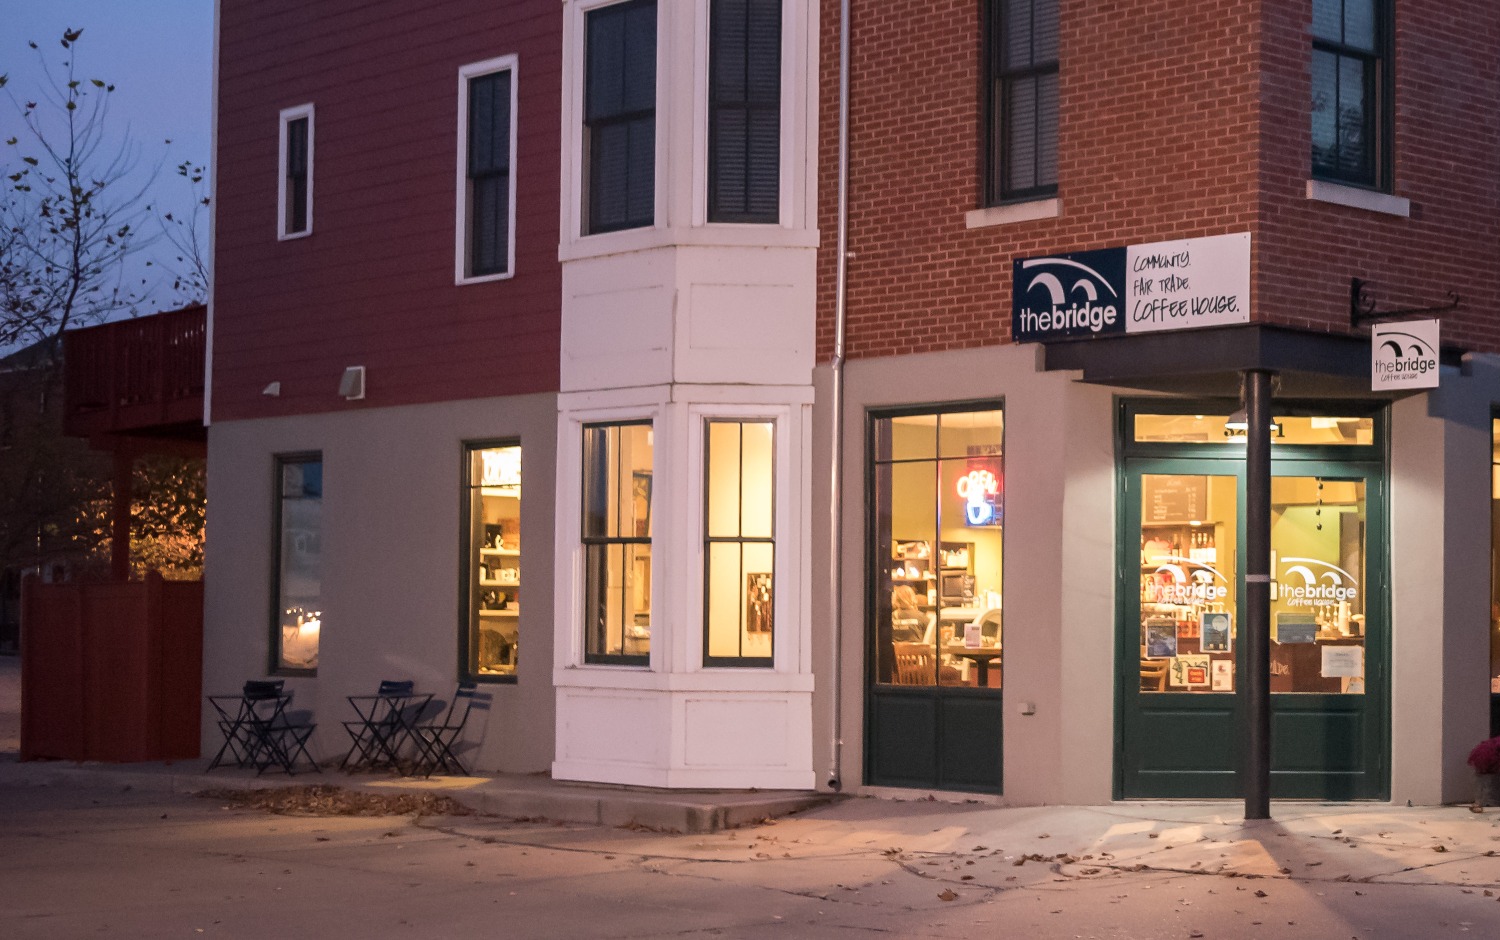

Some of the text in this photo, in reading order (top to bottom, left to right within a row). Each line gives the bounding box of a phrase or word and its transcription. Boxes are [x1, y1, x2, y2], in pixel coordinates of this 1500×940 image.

[1133, 277, 1153, 297] FAIR
[1191, 295, 1240, 315] HOUSE.
[1020, 301, 1117, 332] thebridge
[1375, 357, 1436, 374] thebridge
[1279, 583, 1357, 601] thebridge
